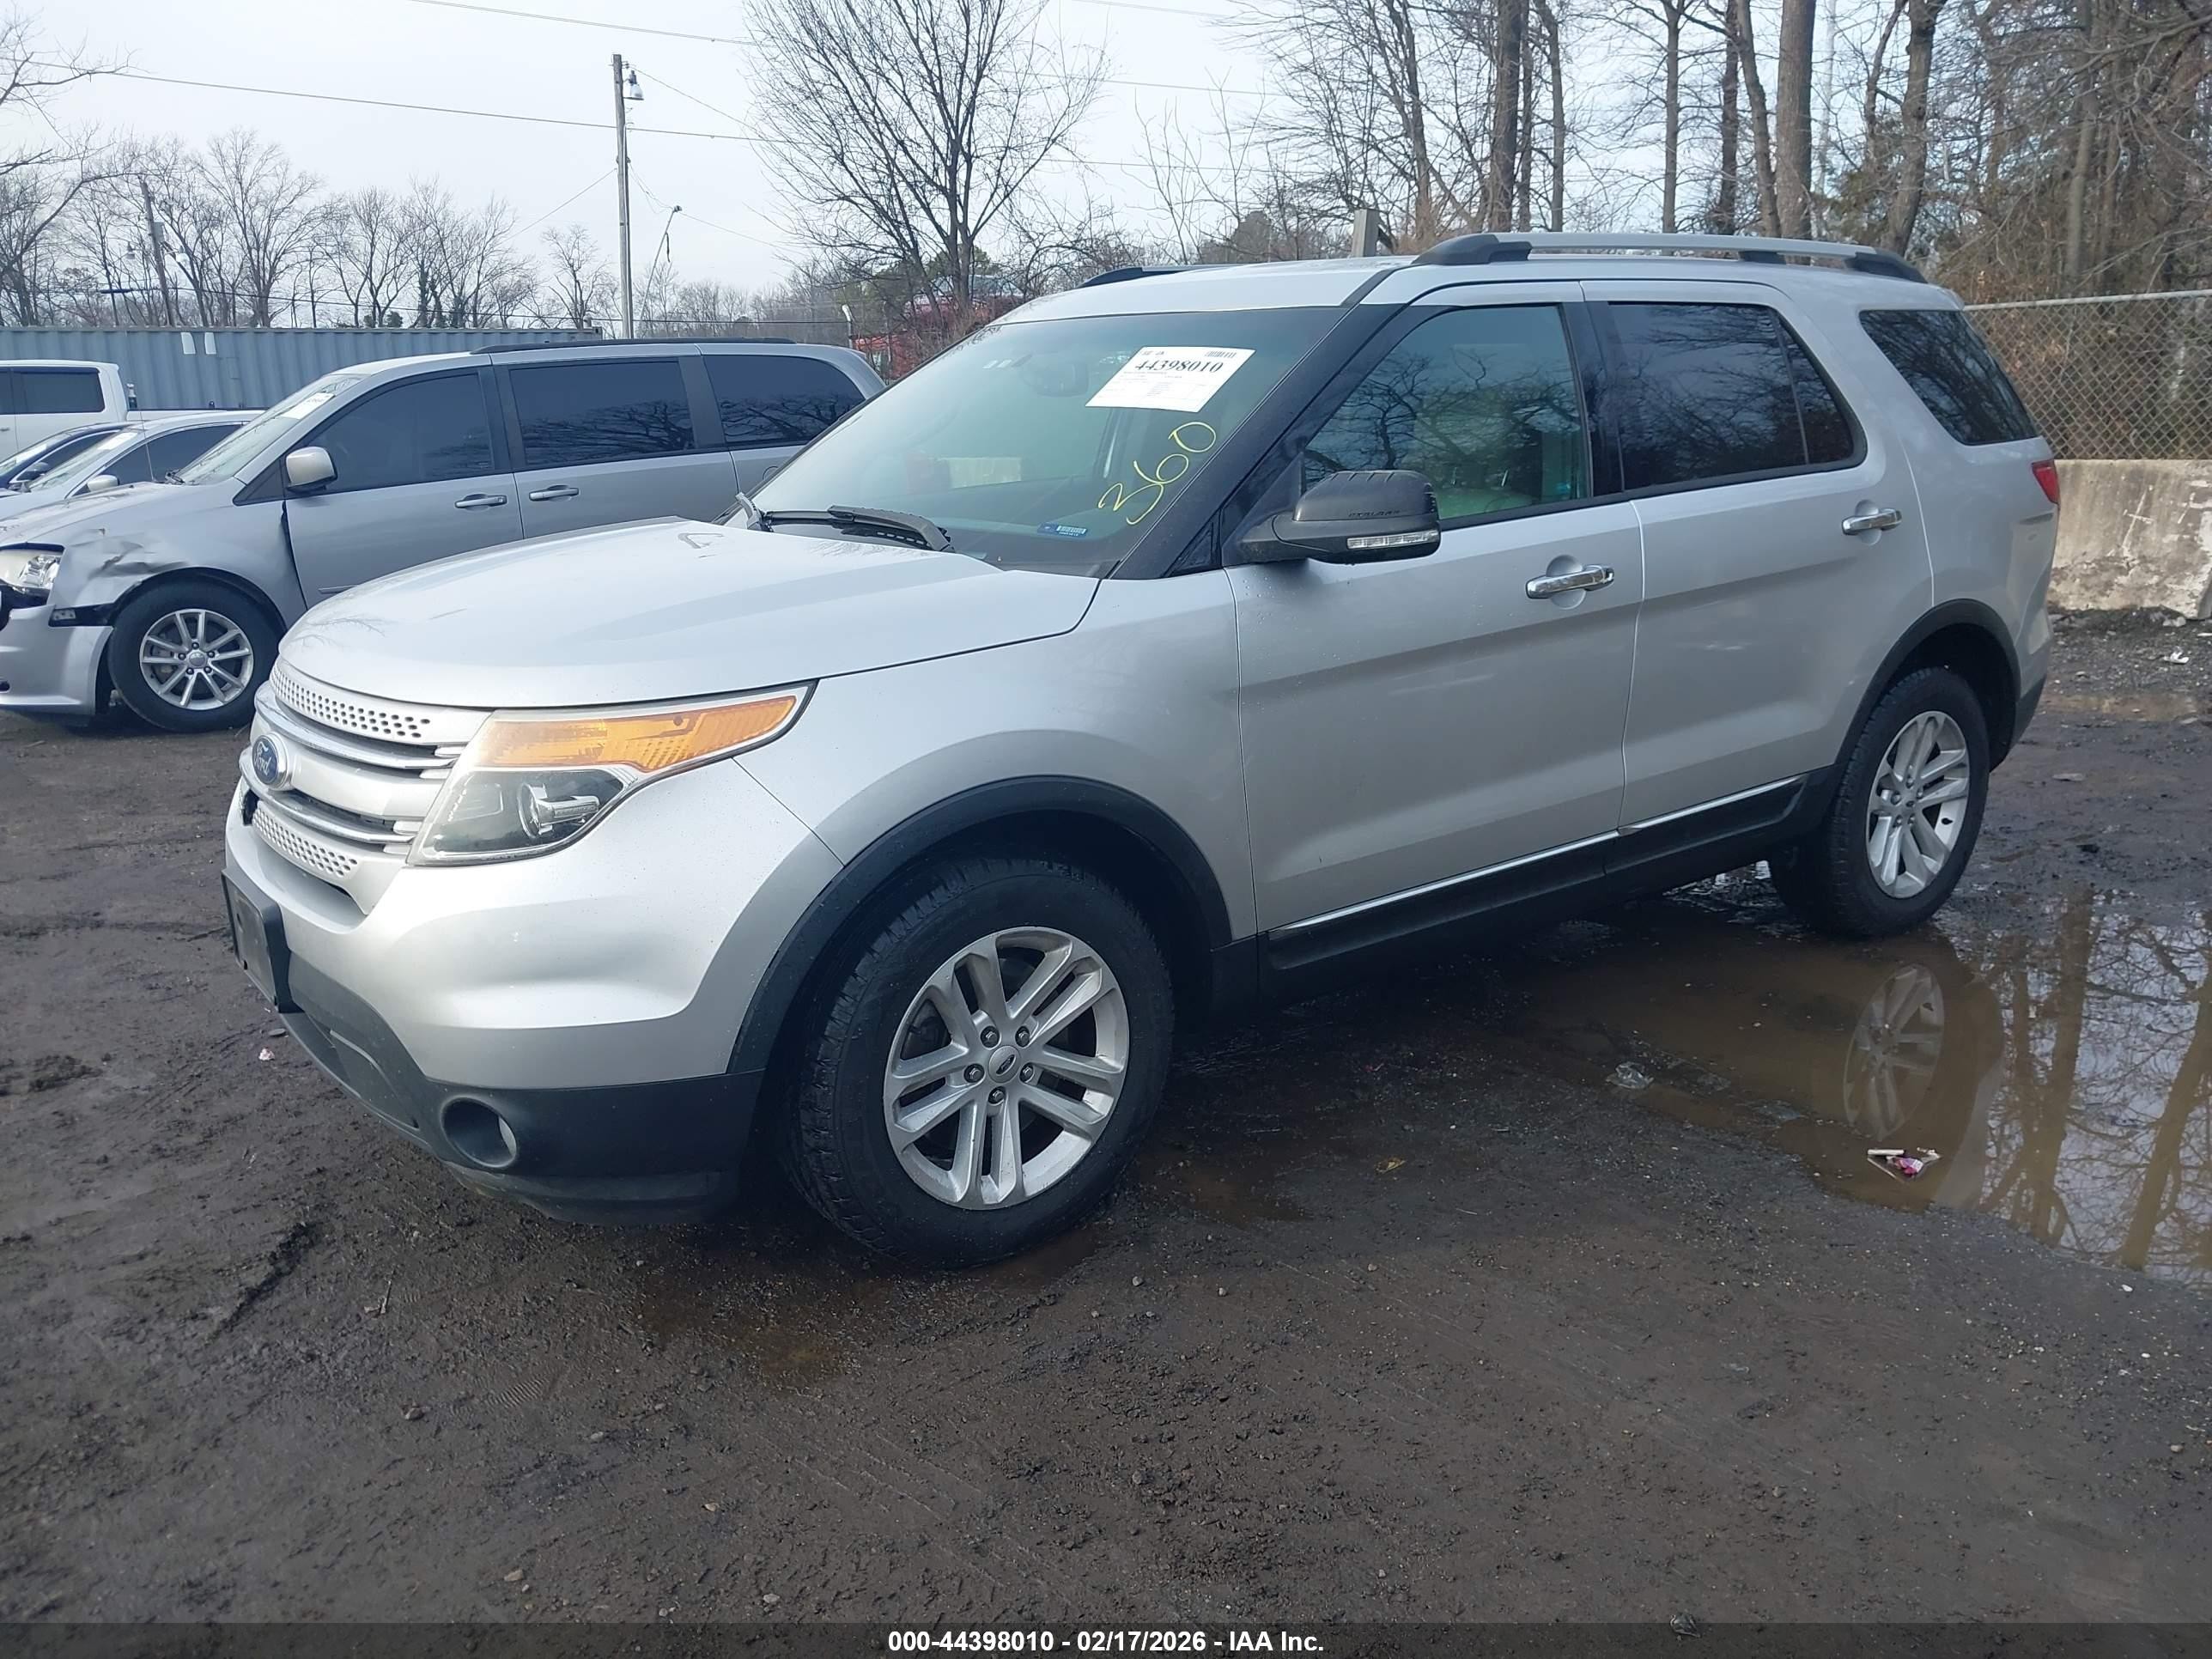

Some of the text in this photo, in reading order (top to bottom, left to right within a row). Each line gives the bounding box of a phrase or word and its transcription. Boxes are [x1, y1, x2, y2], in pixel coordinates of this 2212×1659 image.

[1134, 359, 1224, 374] 44398010
[1097, 421, 1217, 526] 360
[253, 741, 271, 776] Ford
